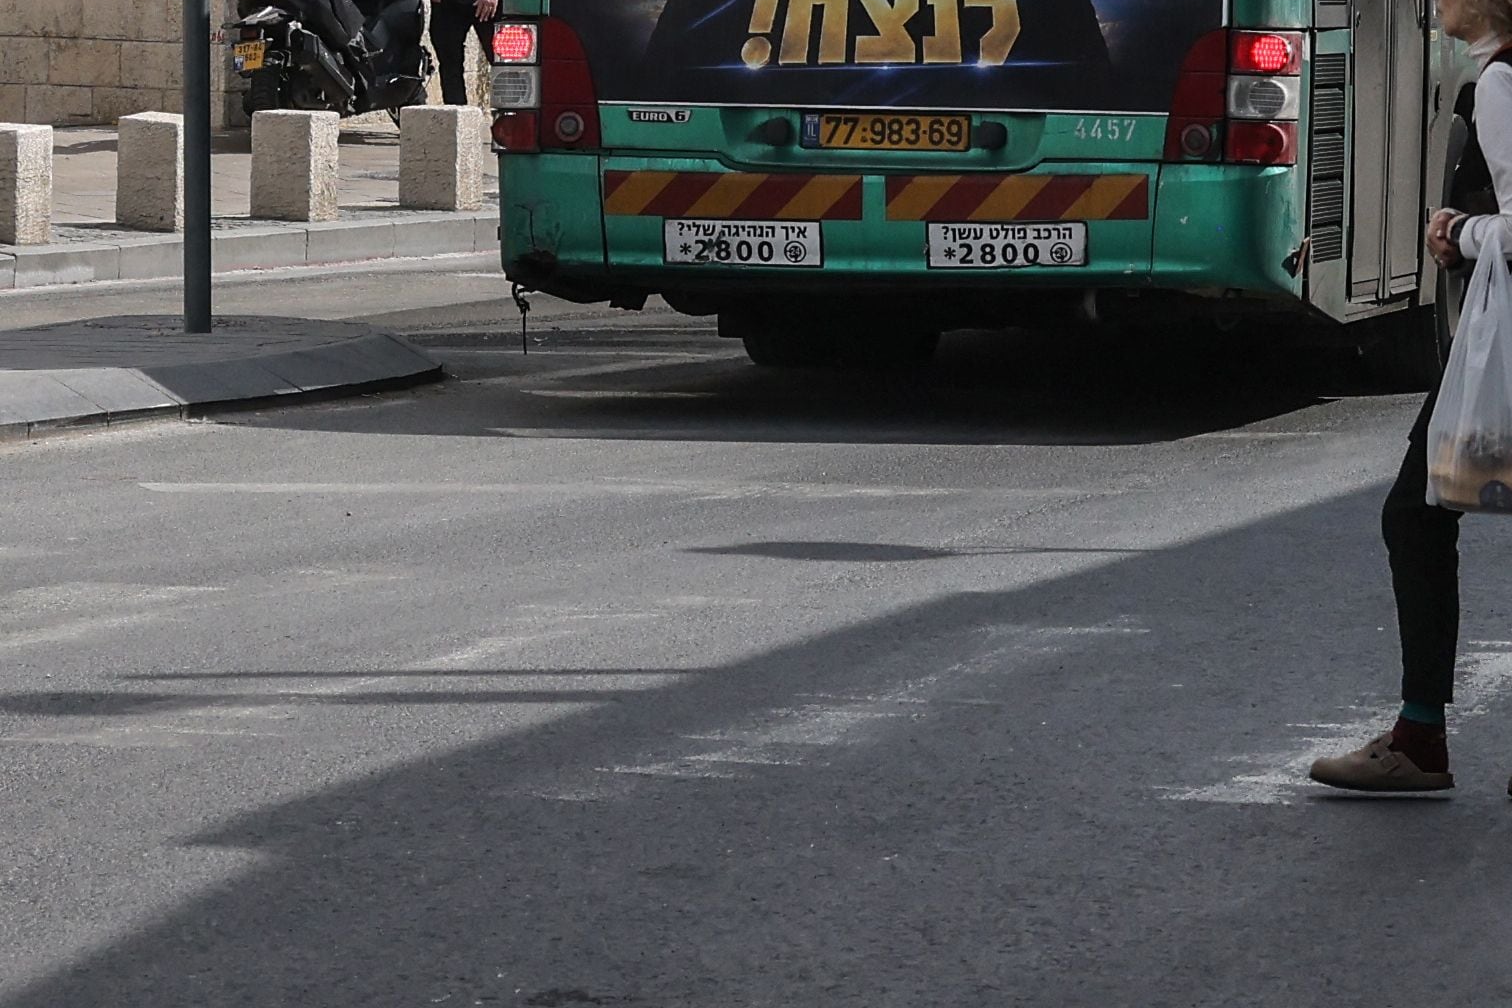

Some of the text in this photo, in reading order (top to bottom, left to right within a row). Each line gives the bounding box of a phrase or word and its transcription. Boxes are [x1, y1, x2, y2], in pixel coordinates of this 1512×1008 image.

[632, 110, 688, 122] EURO 6
[1073, 118, 1137, 142] 4457
[677, 222, 808, 241] איך הנהיגה שלי?
[941, 225, 1073, 243] הרכב פולט עשן?
